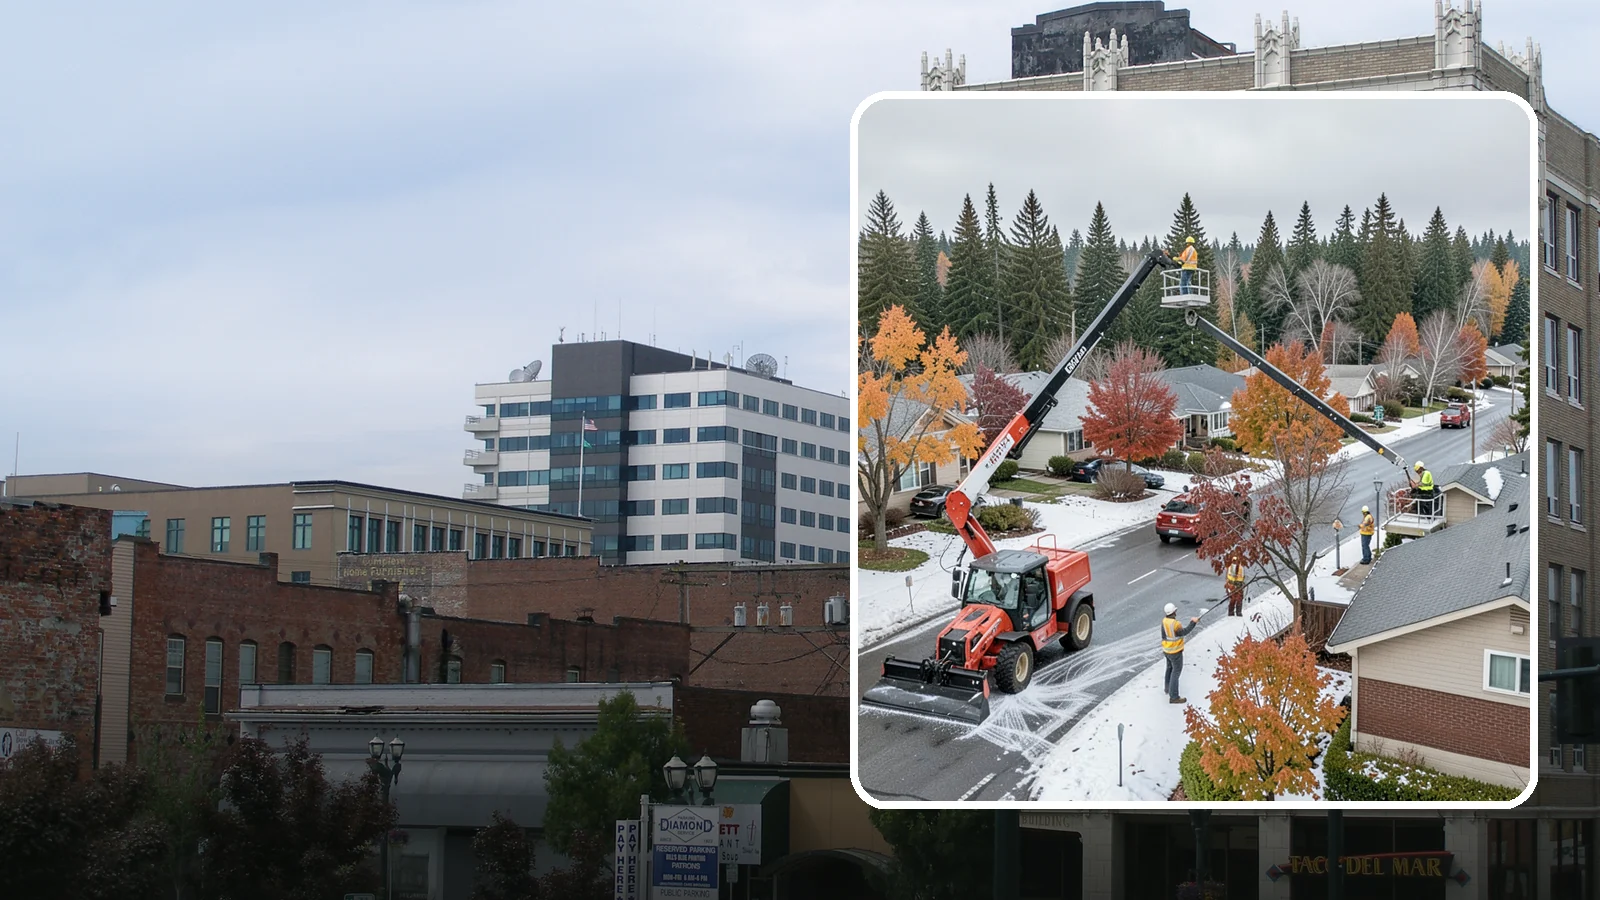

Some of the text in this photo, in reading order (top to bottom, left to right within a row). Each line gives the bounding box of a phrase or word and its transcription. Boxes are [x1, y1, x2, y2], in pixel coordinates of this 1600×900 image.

[370, 565, 427, 576] Furnishers
[660, 818, 713, 832] DIAMOND
[1022, 815, 1070, 827] BUILDING
[719, 823, 740, 835] ETT
[689, 846, 716, 854] PARKING
[616, 824, 625, 893] PAY HERE
[627, 824, 637, 893] PAY HERE
[721, 851, 739, 862] Soup
[671, 862, 701, 870] PATRONS
[1345, 856, 1385, 875] DEL
[1392, 857, 1443, 877] MAR
[660, 888, 710, 898] PUBLIC PARKING
